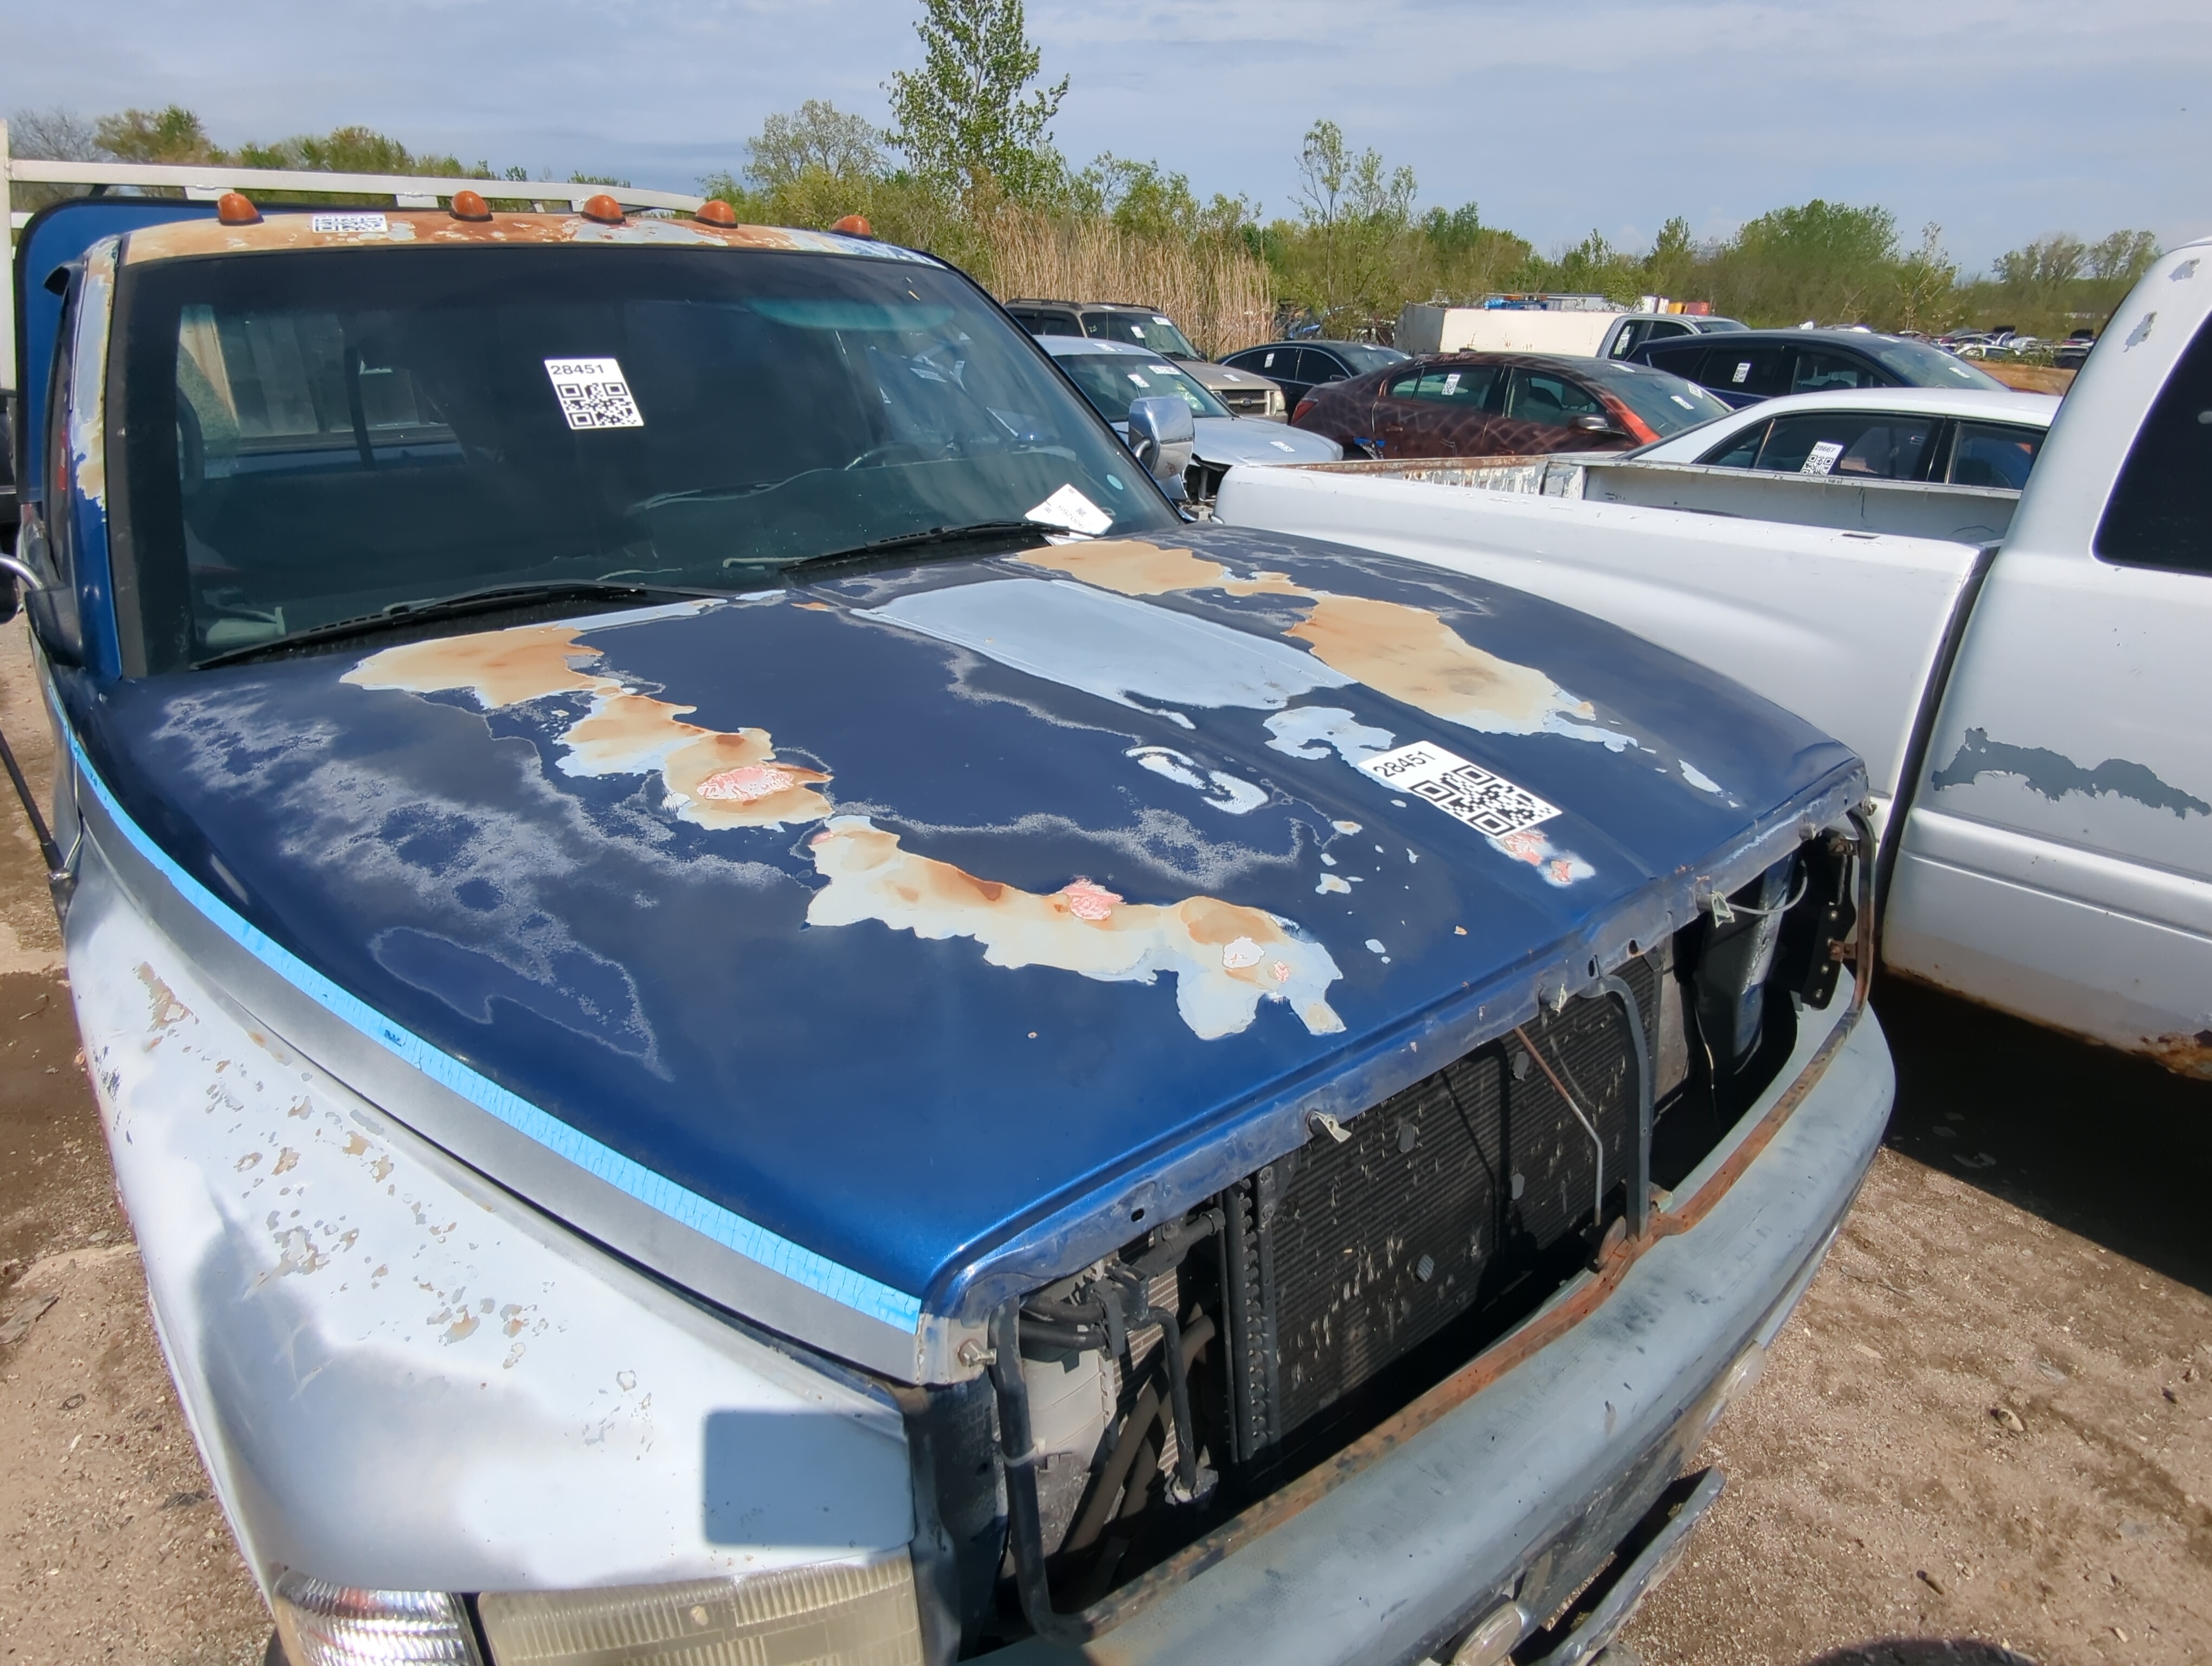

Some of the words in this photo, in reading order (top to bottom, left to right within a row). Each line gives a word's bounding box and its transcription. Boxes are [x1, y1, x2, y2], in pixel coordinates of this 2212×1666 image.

[550, 364, 605, 375] 28451
[1057, 504, 1085, 530] 900269
[1373, 751, 1436, 778] 28451
